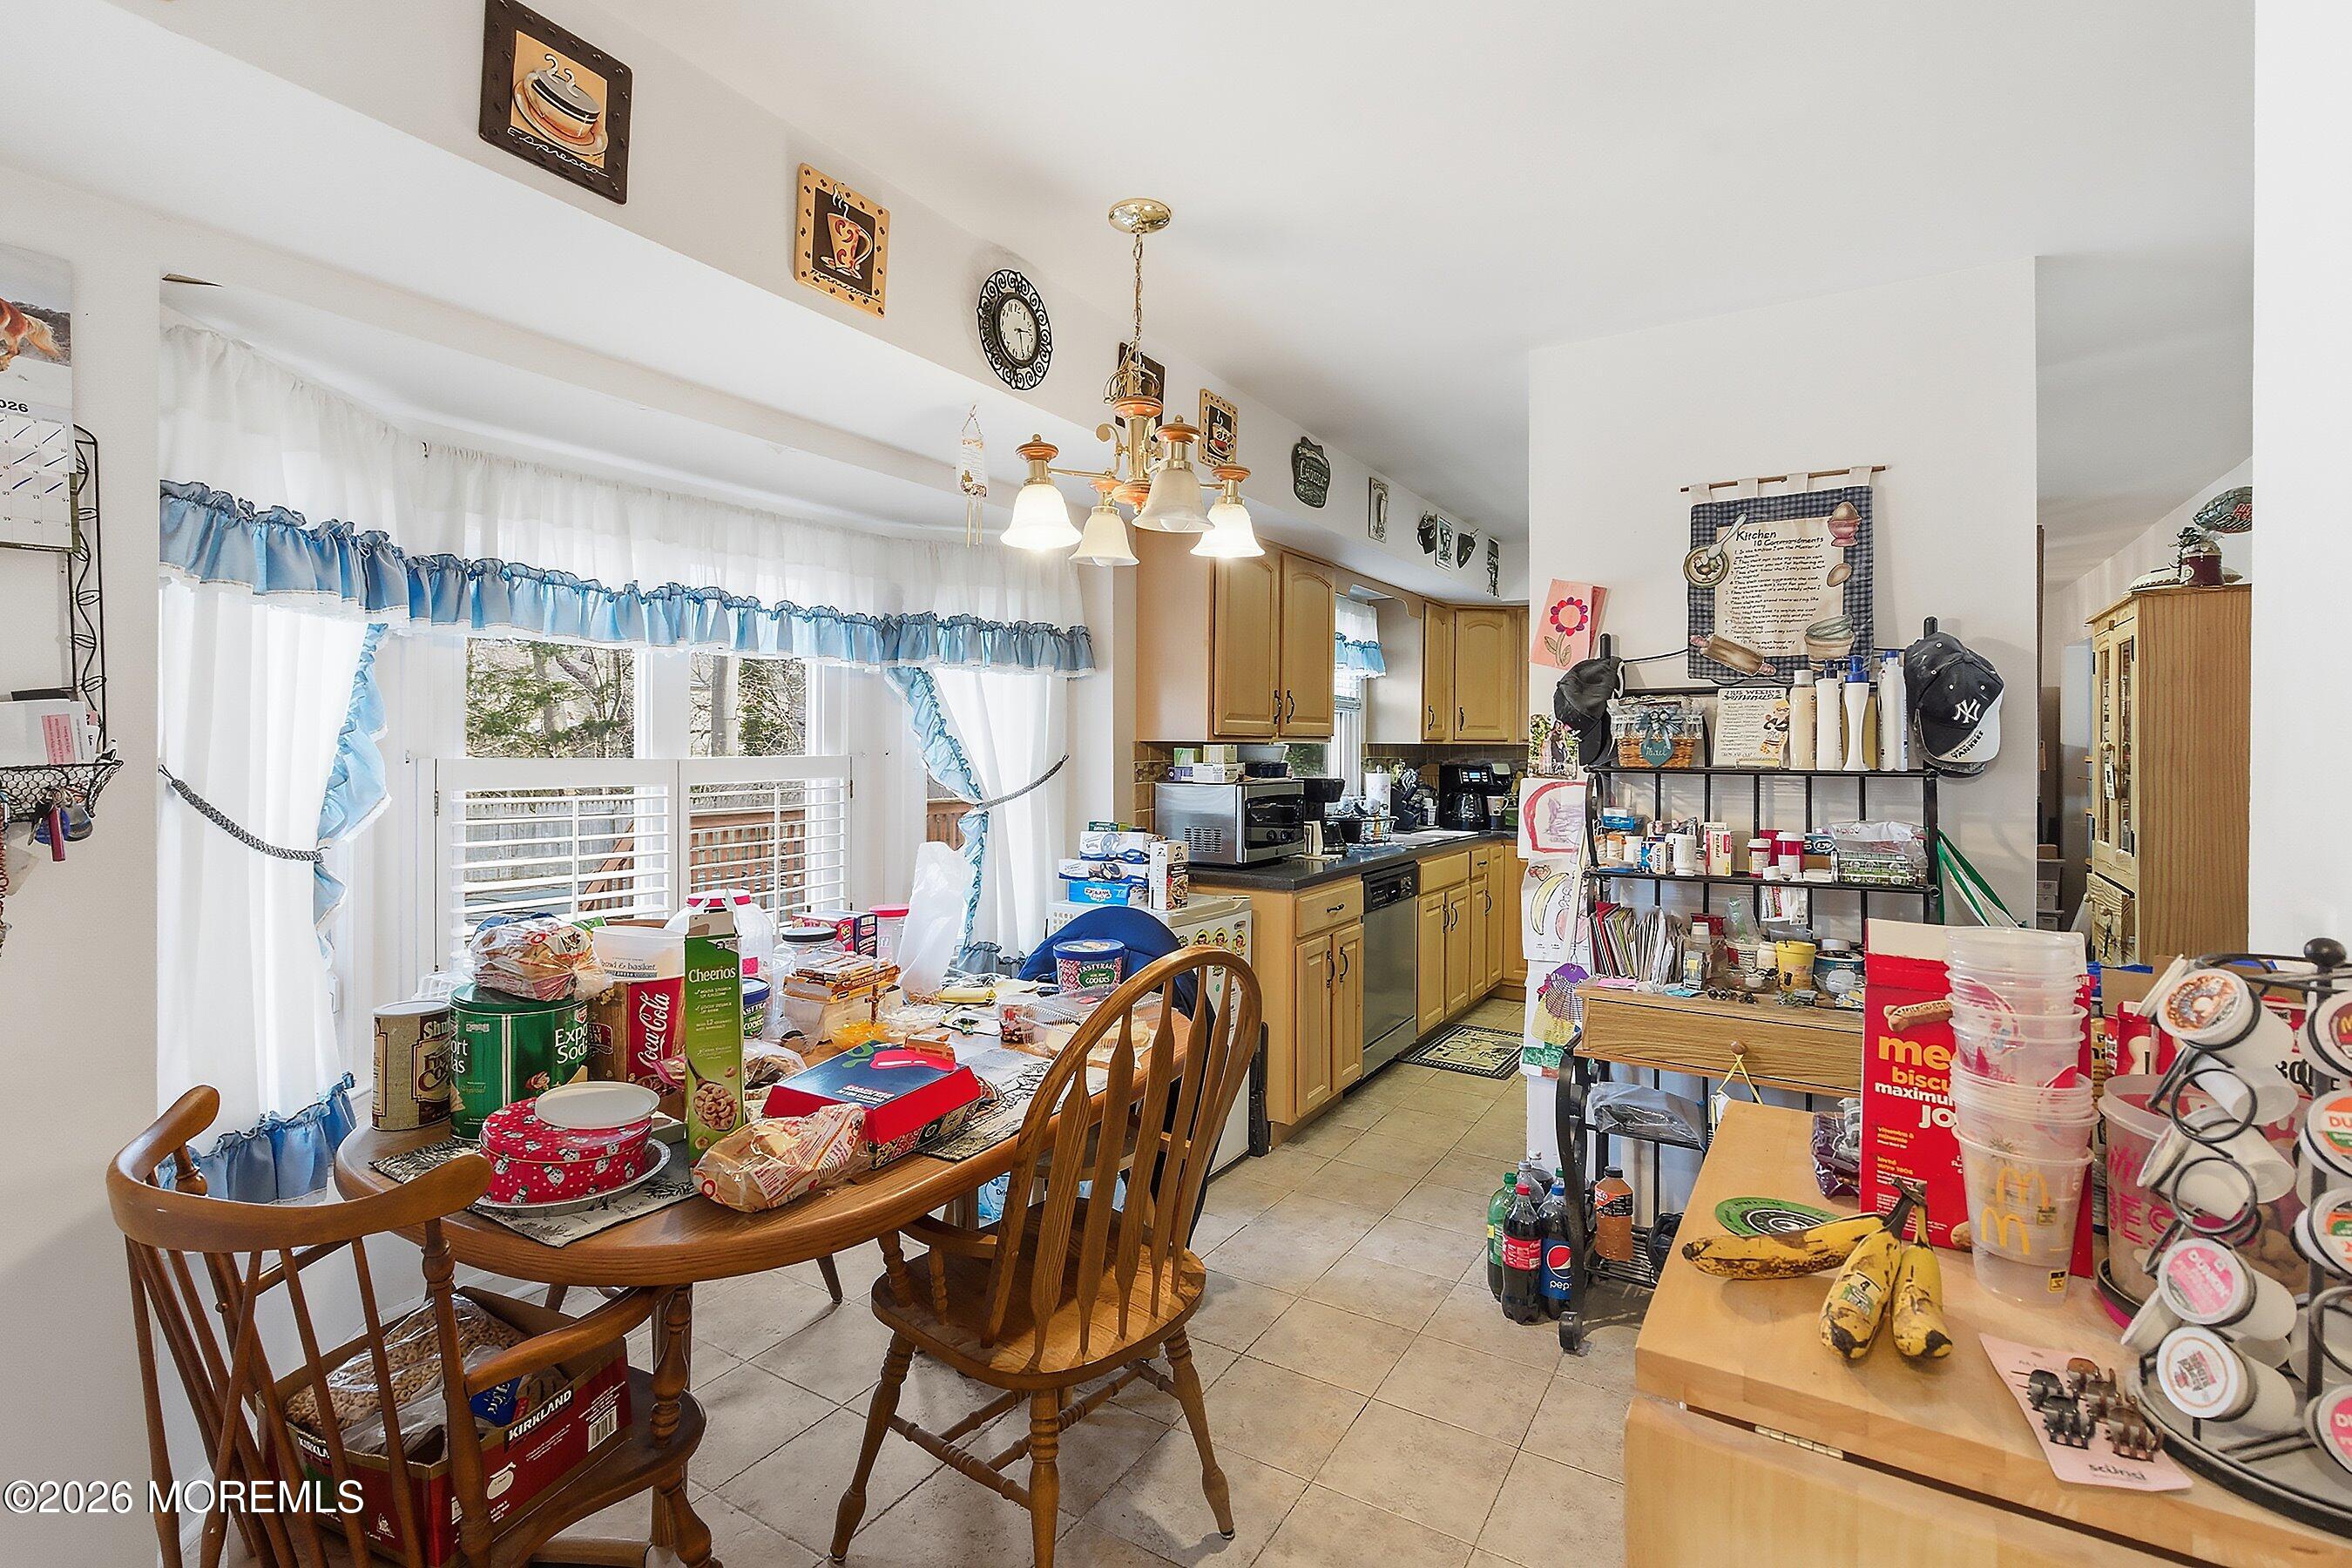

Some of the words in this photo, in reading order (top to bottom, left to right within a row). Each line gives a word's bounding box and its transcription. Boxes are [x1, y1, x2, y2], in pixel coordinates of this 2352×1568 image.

[507, 127, 611, 178] Espresso
[0, 400, 29, 413] 026
[1735, 529, 1777, 541] Kitchen
[1764, 537, 1824, 546] Commandments
[1952, 699, 1981, 724] NY
[688, 966, 736, 983] Cheerios
[555, 1024, 588, 1047] Expo
[1891, 1065, 1951, 1092] biscu
[1550, 1280, 1571, 1291] pep
[509, 1390, 572, 1441] KIRKLAND
[298, 1437, 329, 1459] KIRKLA
